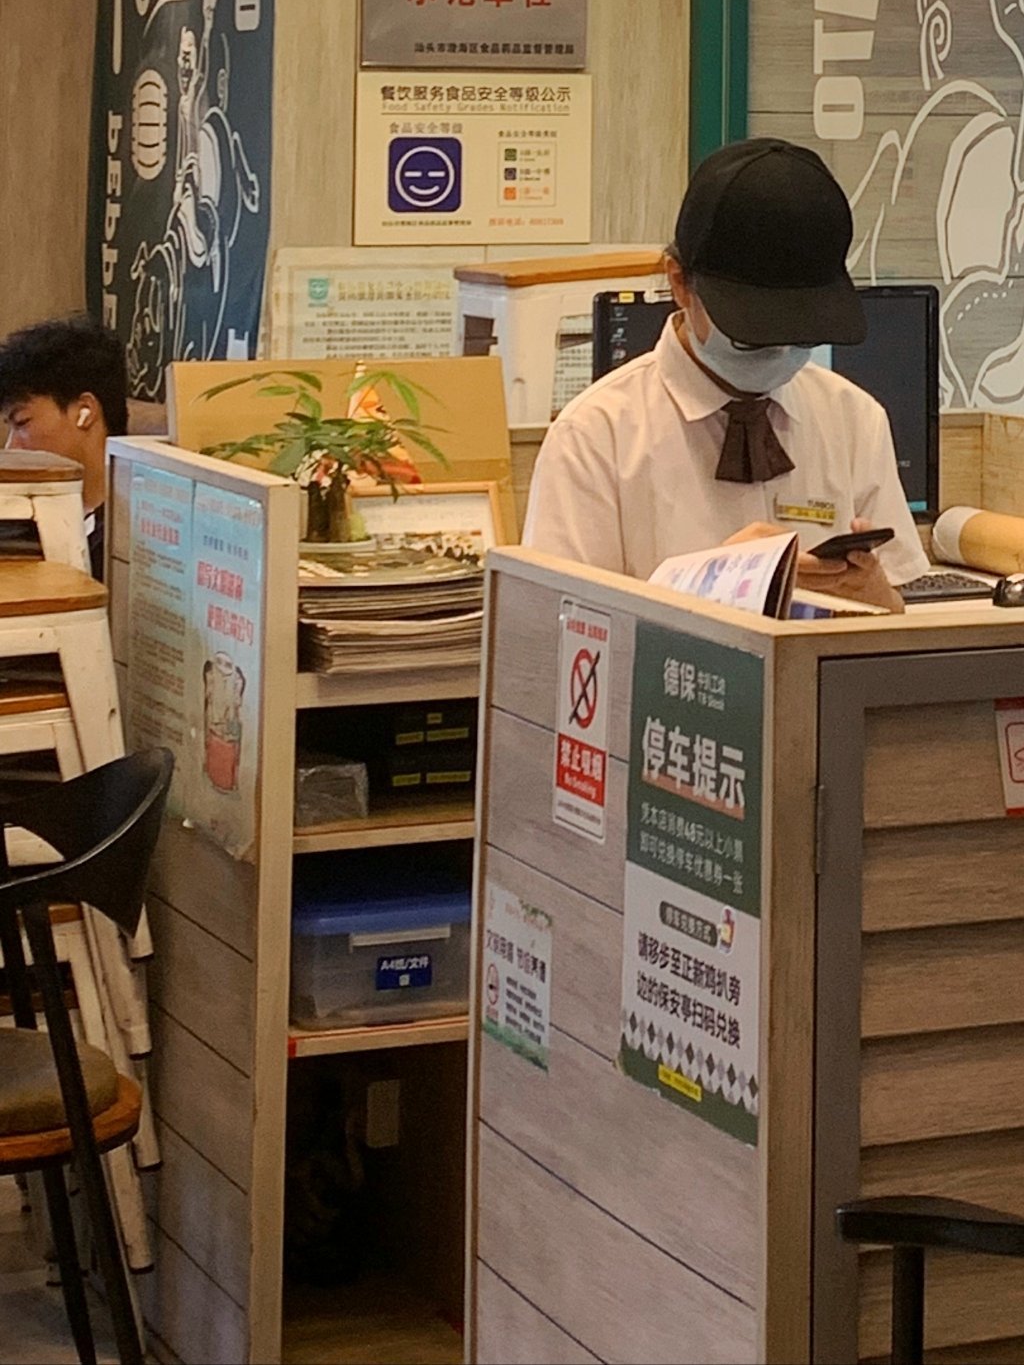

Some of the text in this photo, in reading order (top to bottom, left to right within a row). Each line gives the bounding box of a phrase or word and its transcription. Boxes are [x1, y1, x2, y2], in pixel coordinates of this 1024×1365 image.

[380, 86, 571, 102] 餐饮服务食品安全等级公示
[642, 716, 745, 809] 停车提示
